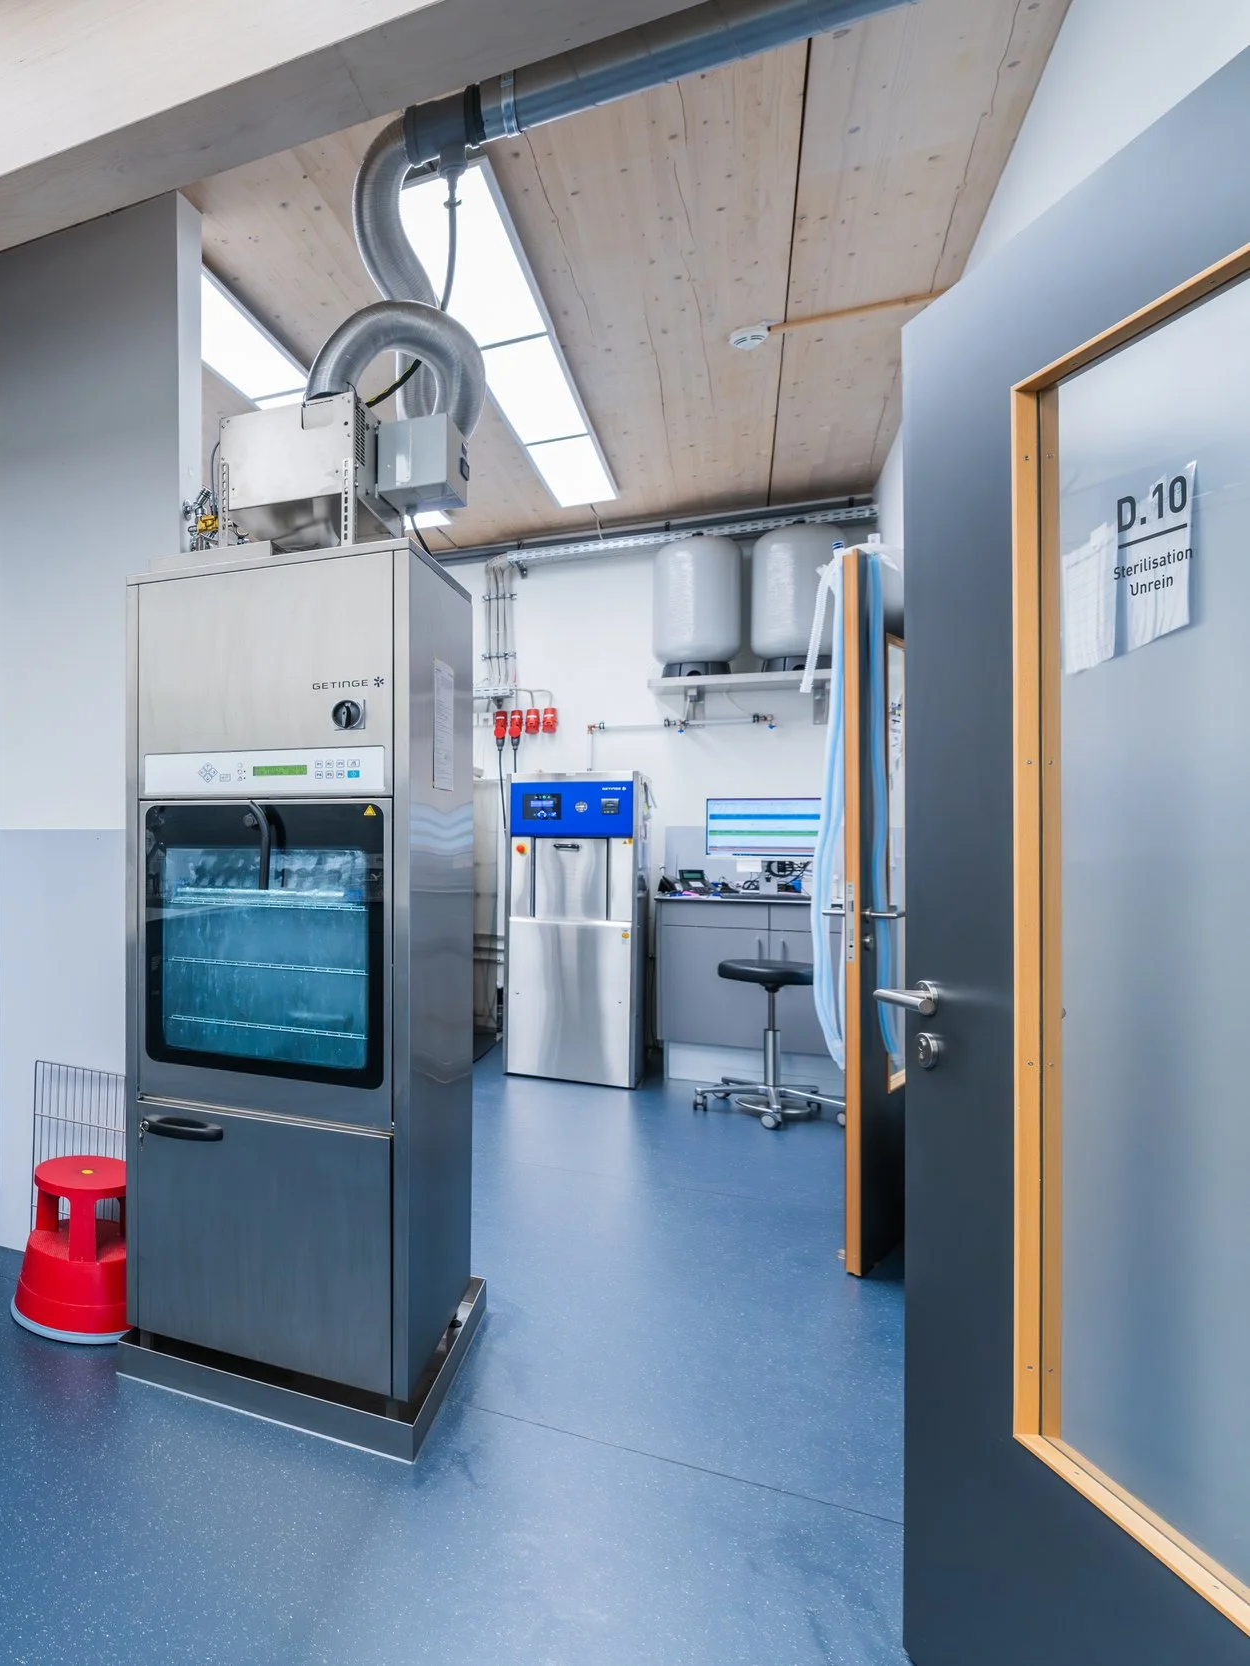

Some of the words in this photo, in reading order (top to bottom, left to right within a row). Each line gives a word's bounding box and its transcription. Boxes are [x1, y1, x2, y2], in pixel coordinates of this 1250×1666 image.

[1116, 475, 1187, 533] D.10
[1113, 548, 1193, 580] Sterilisation
[1130, 574, 1174, 596] Unrein
[312, 679, 369, 690] GETINGE
